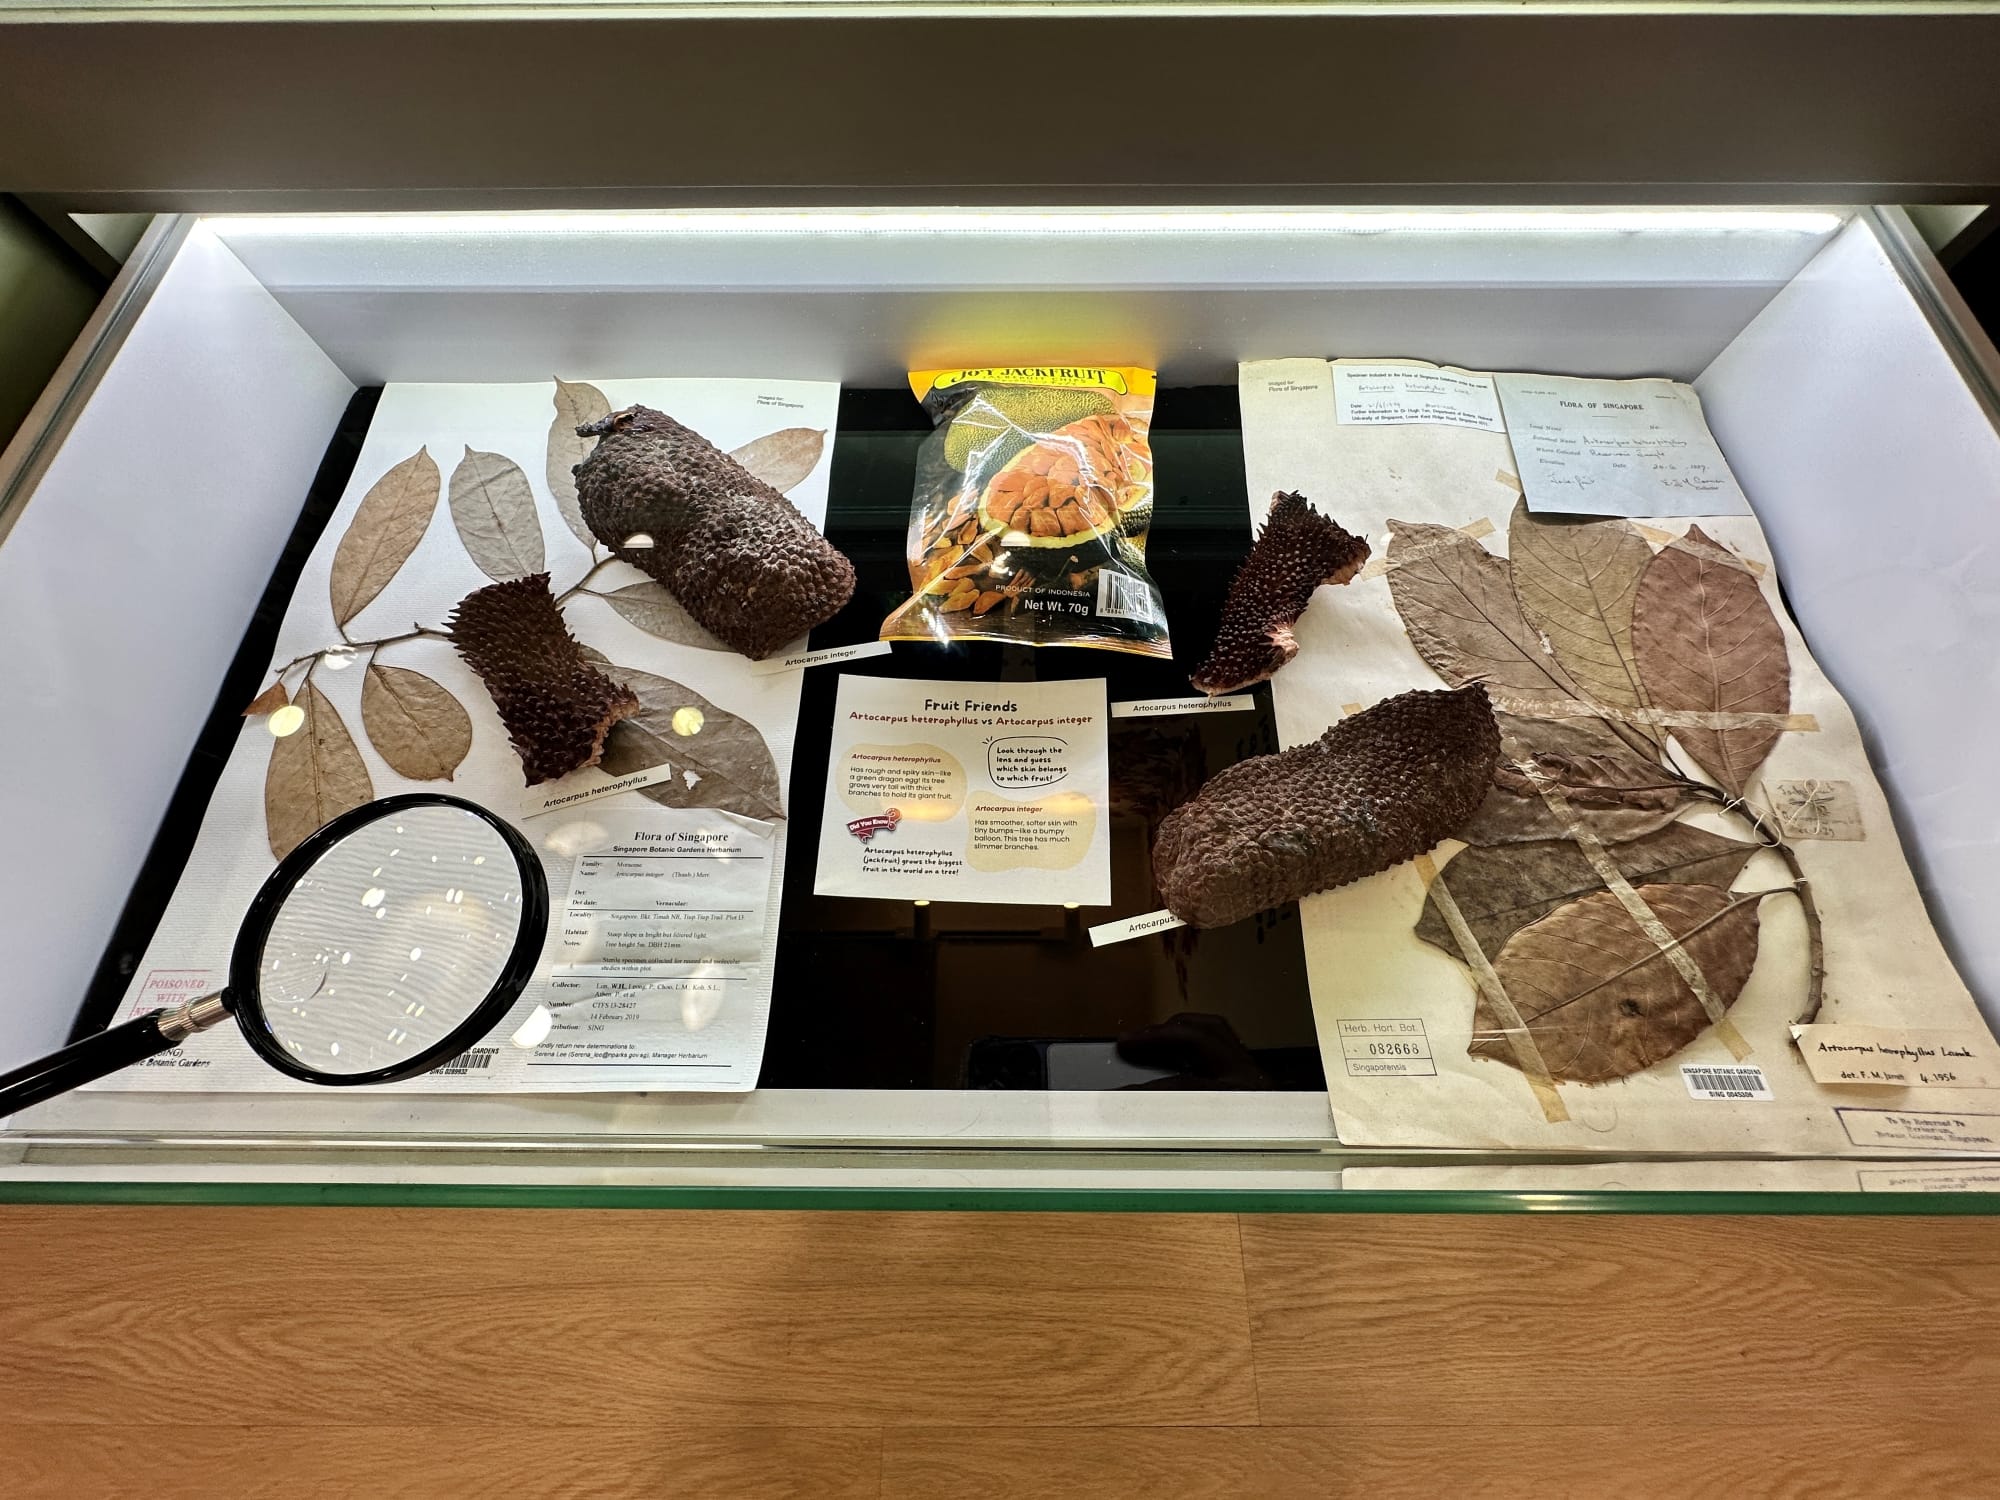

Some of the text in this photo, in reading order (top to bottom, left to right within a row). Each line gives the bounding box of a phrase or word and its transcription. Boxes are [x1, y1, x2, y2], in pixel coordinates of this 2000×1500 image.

[951, 368, 1106, 384] JOY JACKFRUIT
[1559, 400, 1583, 409] FLORA
[1602, 402, 1644, 411] SINGAPORE
[995, 584, 1033, 593] PRODUCT
[1048, 588, 1091, 598] INDONESIA
[1024, 599, 1044, 611] Net
[1046, 601, 1065, 612] Wt.
[1068, 603, 1089, 616] 70g
[784, 648, 857, 667] Artocarpus integer
[924, 698, 1018, 713] Fruit Friends
[1133, 699, 1232, 713] Artocarpus heterophyllus
[849, 711, 1093, 728] Artocarpus heterophyllus vs Artocarpus integer
[1017, 746, 1048, 755] through
[1049, 746, 1063, 754] the
[851, 753, 942, 764] Artocarpus heterophyllus
[1030, 757, 1052, 765] guess
[865, 767, 886, 775] rough
[902, 769, 920, 777] spiky
[1038, 765, 1067, 774] belongs
[856, 775, 877, 783] green
[877, 775, 904, 783] dragon
[904, 776, 921, 784] egg!
[543, 774, 648, 809] Artocarpus heterophyllus
[848, 782, 871, 790] grows
[871, 783, 887, 791] very
[848, 789, 882, 797] branches
[917, 792, 936, 800] giant
[975, 805, 1043, 814] Artocarpus integer
[849, 822, 861, 831] Did
[860, 819, 873, 827] You
[989, 819, 1026, 827] smoother,
[974, 827, 988, 835] tiny
[1039, 828, 1065, 836] bumpy
[633, 831, 729, 844] Flora of Singapore
[612, 845, 648, 854] Singapore
[676, 846, 705, 854] Gardens
[706, 846, 742, 854] Herbarium
[864, 847, 953, 857] Artocarpus heterophyllus
[863, 855, 900, 865] (jackfruit)
[938, 859, 963, 868] biggest
[941, 868, 959, 876] tree!
[1128, 916, 1175, 933] Artocarpus
[149, 979, 205, 989] POISONED
[551, 981, 582, 989] Collector:
[156, 993, 187, 1003] WITH
[598, 1013, 624, 1022] February
[587, 1024, 605, 1032] SING
[1343, 1023, 1370, 1033] Herb.
[471, 1047, 500, 1055] GARDENS
[1369, 1042, 1420, 1055] 082668
[1817, 1042, 1874, 1055] Artocarpus
[651, 1052, 678, 1060] Manager
[147, 1058, 211, 1068] Botanic Gardens
[1352, 1063, 1407, 1073] Singaporensis
[1682, 1067, 1712, 1075] SINGAPORE
